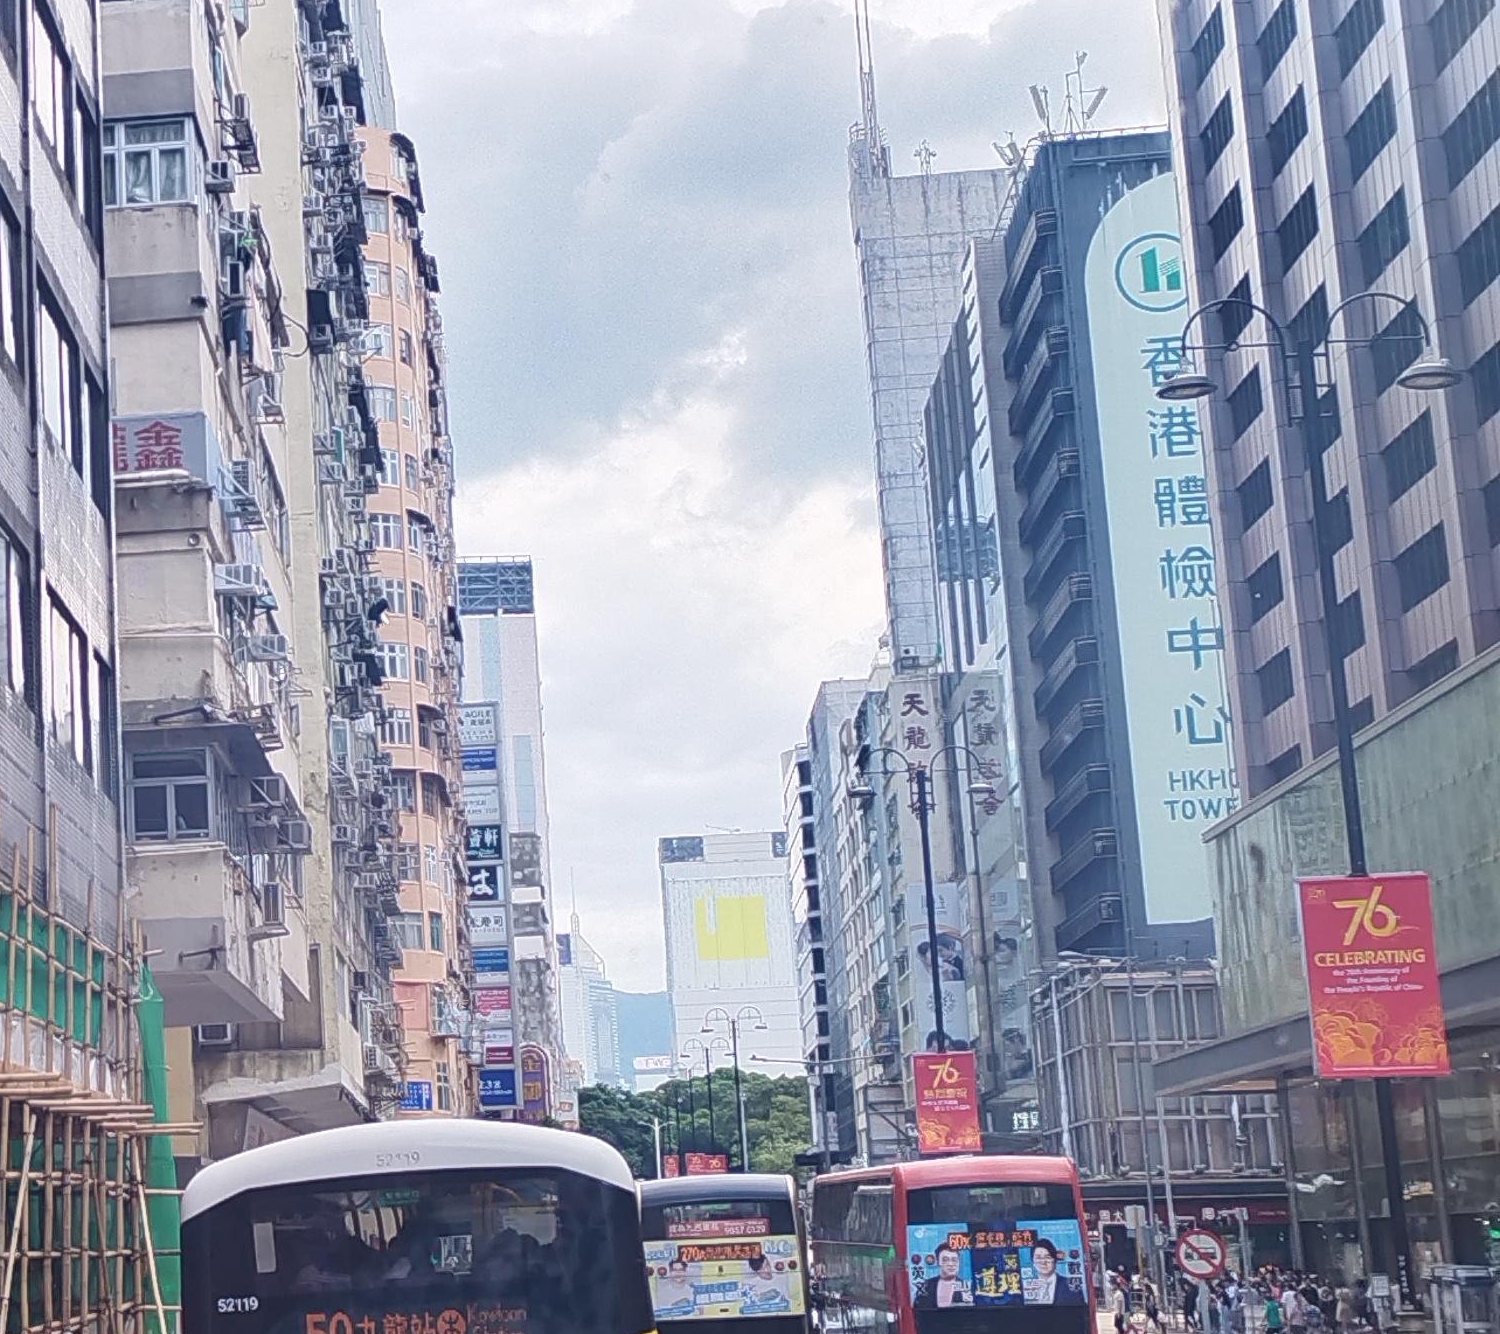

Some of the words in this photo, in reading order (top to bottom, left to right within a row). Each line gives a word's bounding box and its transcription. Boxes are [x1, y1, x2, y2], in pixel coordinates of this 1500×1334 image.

[1141, 335, 1232, 745] 香港體檢中心
[1332, 886, 1397, 945] 76
[1314, 948, 1426, 967] CELEBRATING
[928, 1058, 959, 1089] 76
[217, 1296, 259, 1313] 52119
[467, 1305, 527, 1322] Kowloon
